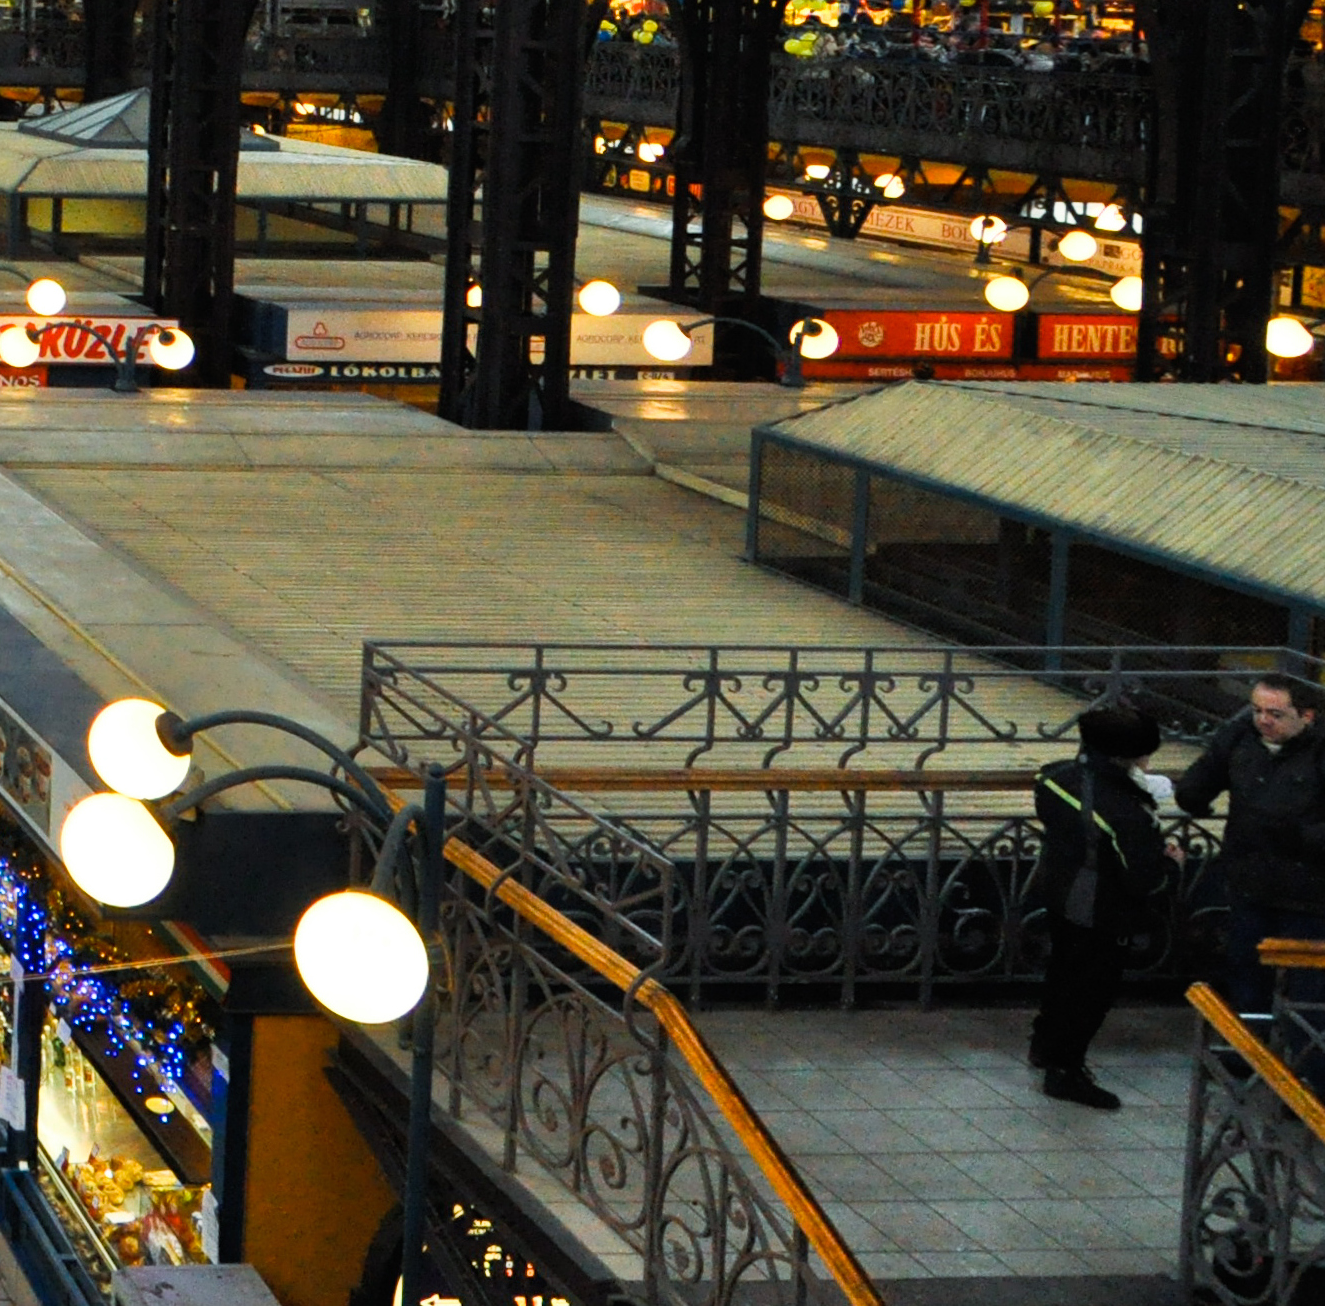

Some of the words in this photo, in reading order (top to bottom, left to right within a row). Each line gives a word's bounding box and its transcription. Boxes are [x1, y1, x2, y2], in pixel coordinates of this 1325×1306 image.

[913, 316, 961, 352] HÚS
[973, 316, 1002, 352] ÉS
[329, 363, 441, 378] LÓKOLBÁ
